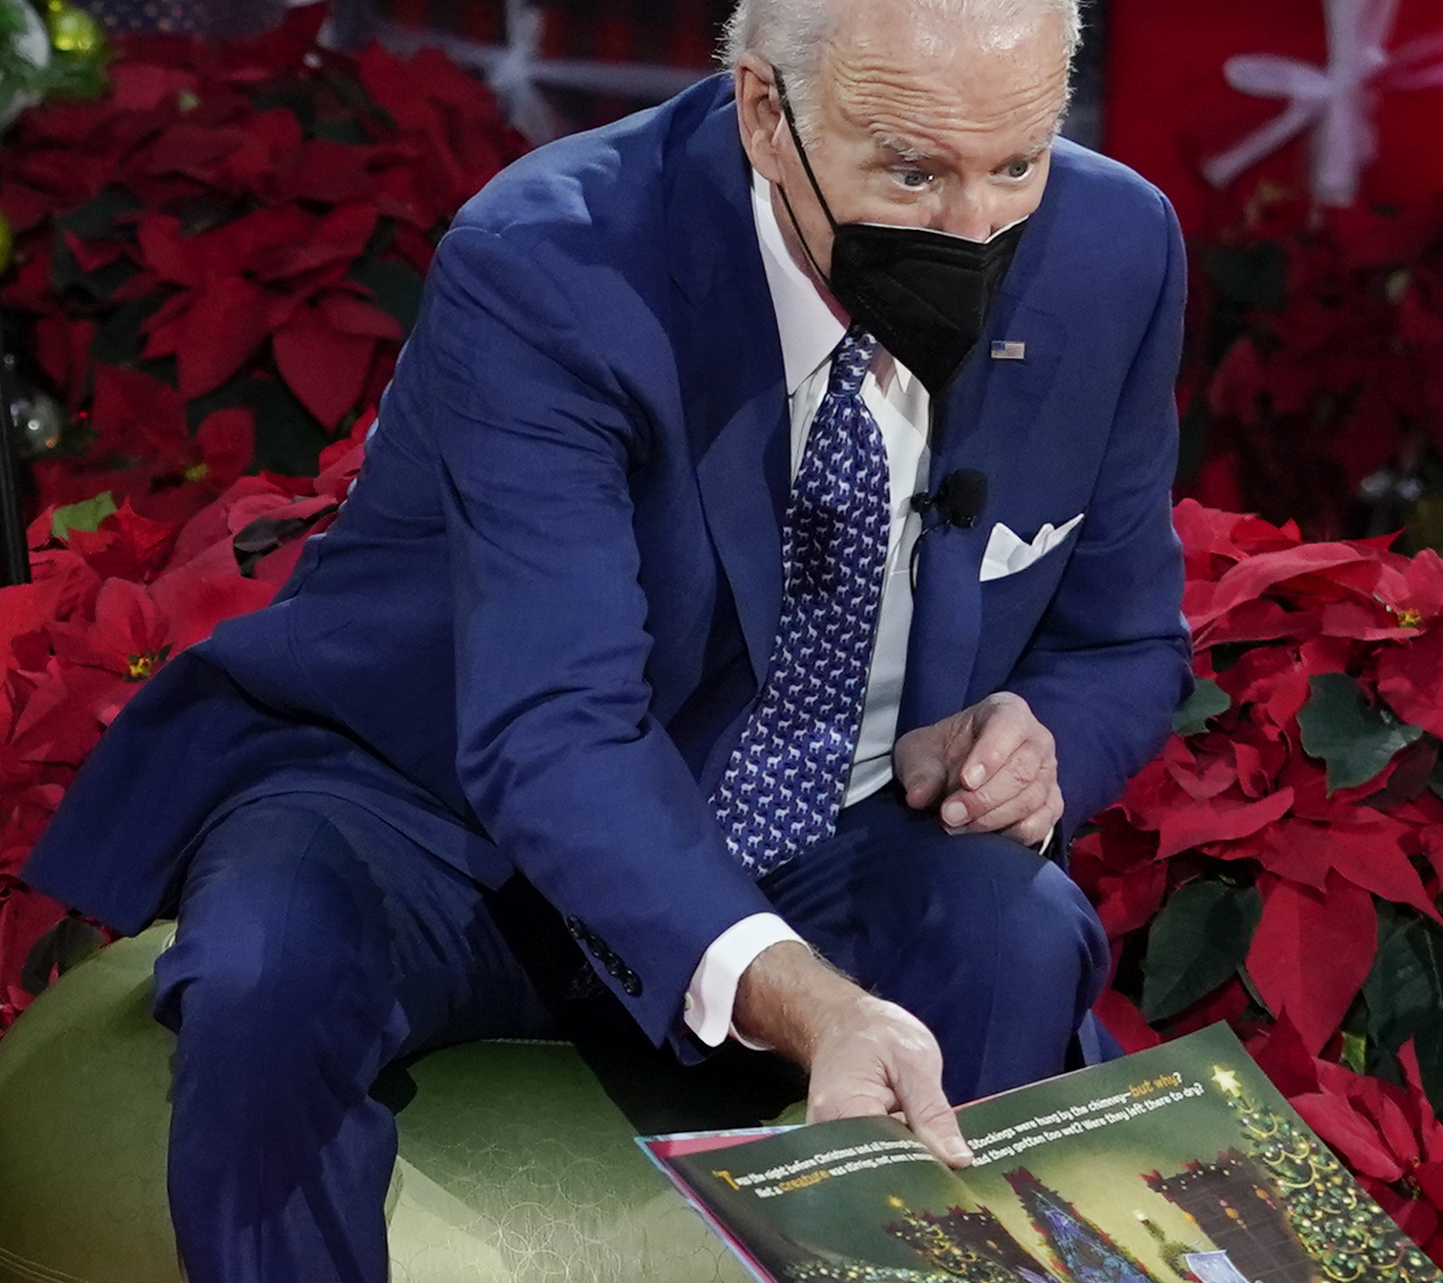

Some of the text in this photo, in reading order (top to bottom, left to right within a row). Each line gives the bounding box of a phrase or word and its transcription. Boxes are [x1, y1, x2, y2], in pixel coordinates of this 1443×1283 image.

[967, 1127, 1016, 1150] Stockings
[1014, 1118, 1038, 1133] were
[1036, 1112, 1061, 1128] hung
[1060, 1108, 1074, 1123] by
[1071, 1104, 1089, 1116] the
[1153, 1071, 1183, 1090] why?
[988, 1145, 1014, 1162] they
[1012, 1135, 1046, 1154] gotten
[1043, 1130, 1062, 1142] too
[1082, 1118, 1107, 1132] Were
[1105, 1110, 1130, 1128] they
[1127, 1103, 1147, 1118] left
[1145, 1095, 1172, 1112] there
[1170, 1089, 1184, 1103] to
[814, 1147, 856, 1165] Christmas
[779, 1170, 831, 1192] creature
